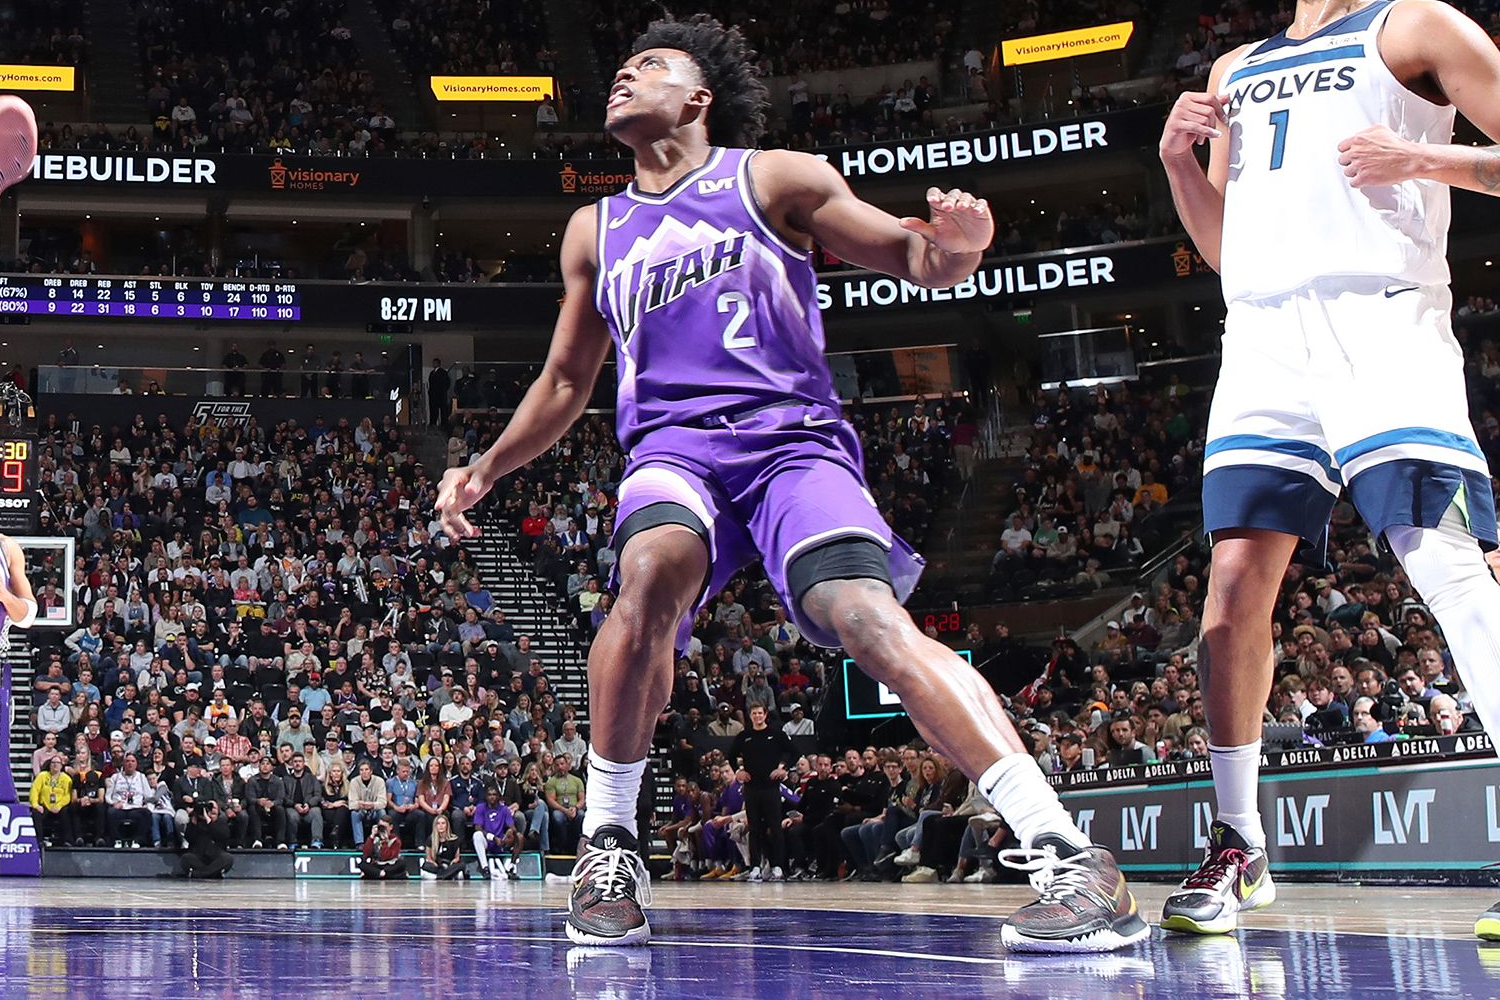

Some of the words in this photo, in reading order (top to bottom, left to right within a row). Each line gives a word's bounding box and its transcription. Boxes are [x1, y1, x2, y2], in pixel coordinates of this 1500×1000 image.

[1016, 33, 1120, 55] VisionaryHomes.com
[443, 85, 541, 94] VisionaryHomes.com
[1229, 66, 1356, 115] WOLVES
[842, 120, 1108, 176] HOMEBUILDER
[1269, 109, 1289, 170] 1
[288, 168, 360, 186] visionary
[290, 182, 324, 190] HOMES
[698, 176, 736, 195] LVT
[581, 185, 615, 193] HOMES
[0, 277, 8, 285] FT
[98, 280, 111, 288] REB
[123, 281, 137, 289] AST
[150, 282, 162, 290] STL
[201, 283, 214, 291] TOV
[224, 283, 245, 292] BENCH
[606, 231, 752, 344] UTAH
[0, 287, 28, 298] (67%)
[48, 288, 56, 299] 8
[72, 289, 83, 299] 14
[97, 290, 111, 300] 22
[124, 290, 135, 300] 15
[151, 291, 159, 301] 5
[177, 291, 185, 302] 6
[203, 292, 210, 302] 9
[227, 293, 241, 303] 24
[251, 294, 267, 304] 110
[277, 294, 292, 304] 110
[48, 302, 56, 313] 9
[71, 303, 84, 313] 22
[98, 304, 109, 314] 31
[124, 304, 135, 314] 18
[151, 305, 159, 315] 6
[177, 305, 185, 316] 3
[201, 306, 212, 316] 10
[228, 307, 239, 317] 17
[251, 307, 267, 317] 110
[277, 307, 292, 318] 110
[381, 298, 417, 321] 8:27
[424, 298, 451, 321] PM
[716, 292, 757, 350] 2
[1076, 771, 1098, 783] DELTA
[1112, 767, 1136, 779] DELTA
[1152, 763, 1176, 776] DELTA
[1290, 751, 1321, 764] DELTA
[1343, 745, 1377, 760] DELTA
[1402, 740, 1439, 755] DELTA
[1121, 805, 1163, 851] LVT
[1276, 794, 1330, 847] LVT
[1372, 788, 1437, 845] LVT
[1, 843, 32, 853] FIRST
